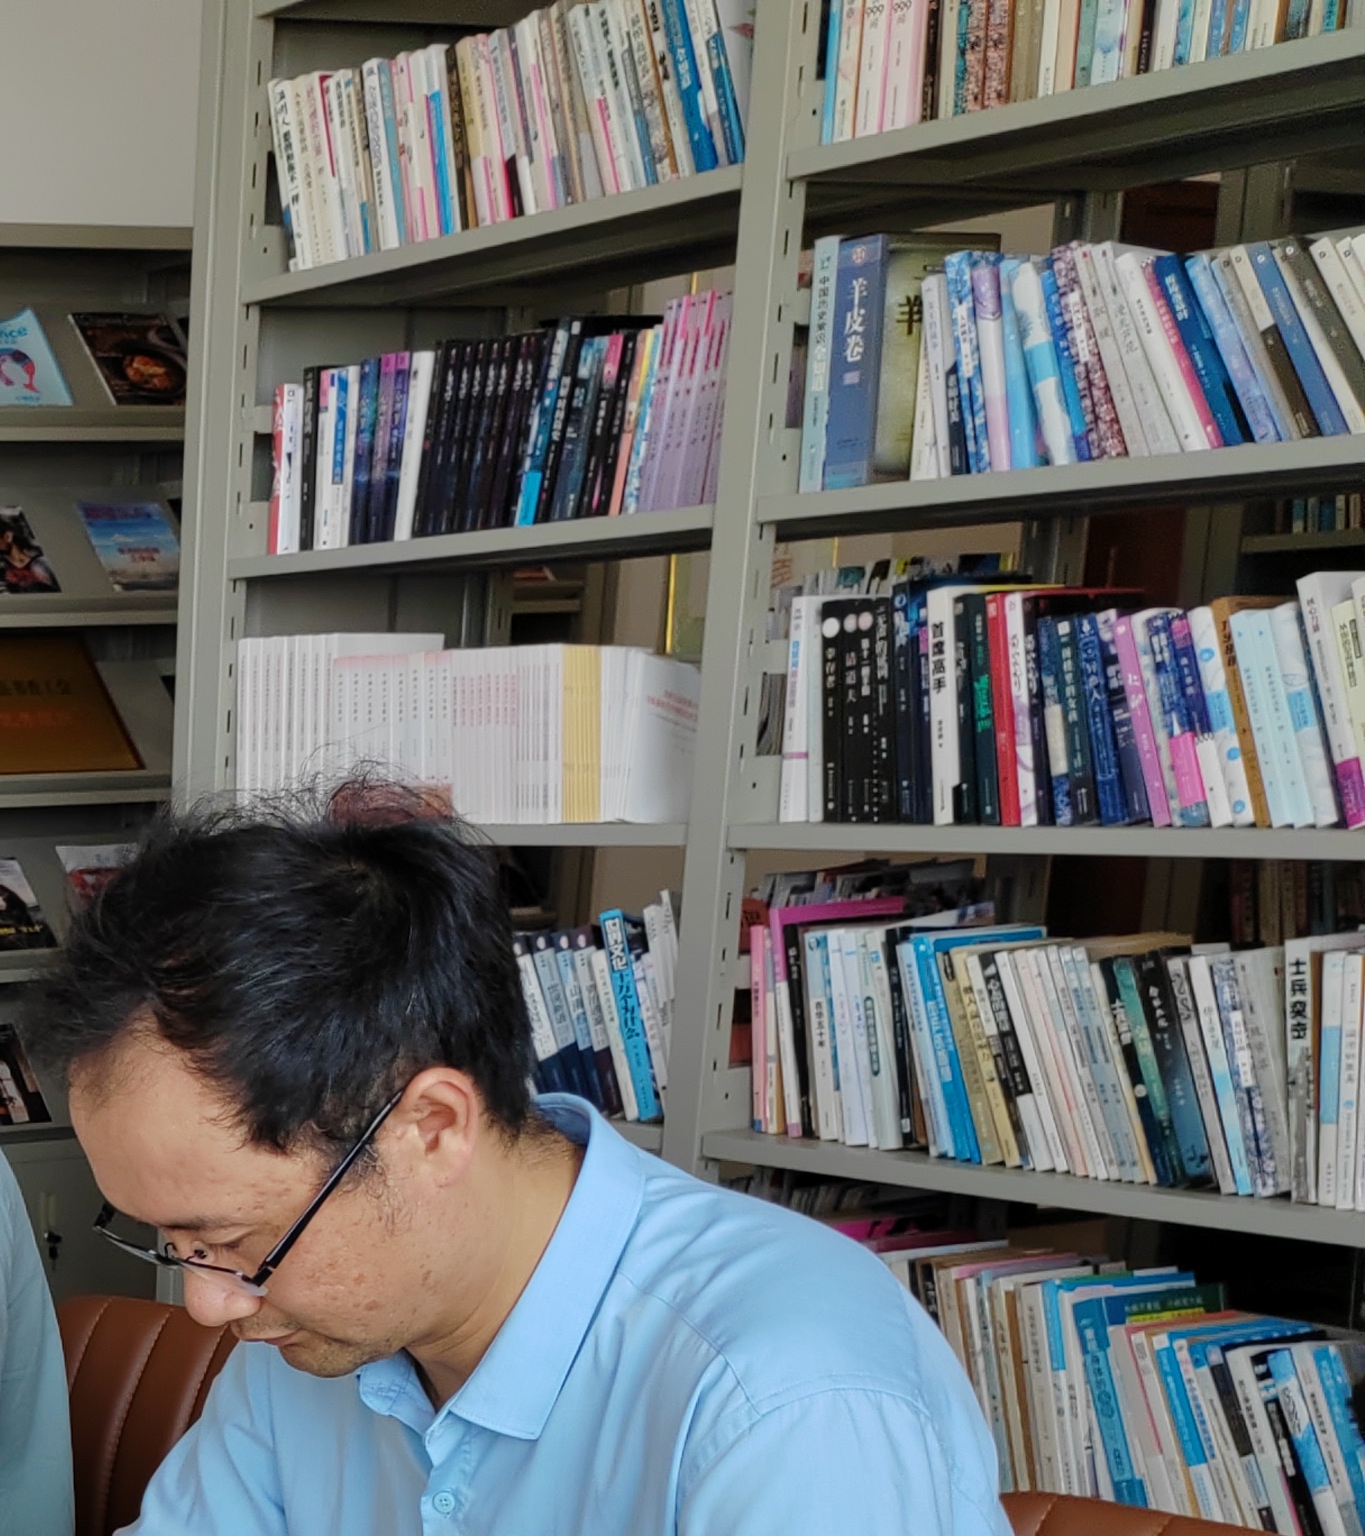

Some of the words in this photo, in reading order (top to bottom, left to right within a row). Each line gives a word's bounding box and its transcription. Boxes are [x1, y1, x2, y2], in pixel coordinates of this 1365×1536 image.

[844, 278, 868, 363] 羊皮卷
[930, 621, 947, 694] 首席高手
[1289, 958, 1308, 1040] 士兵突击
